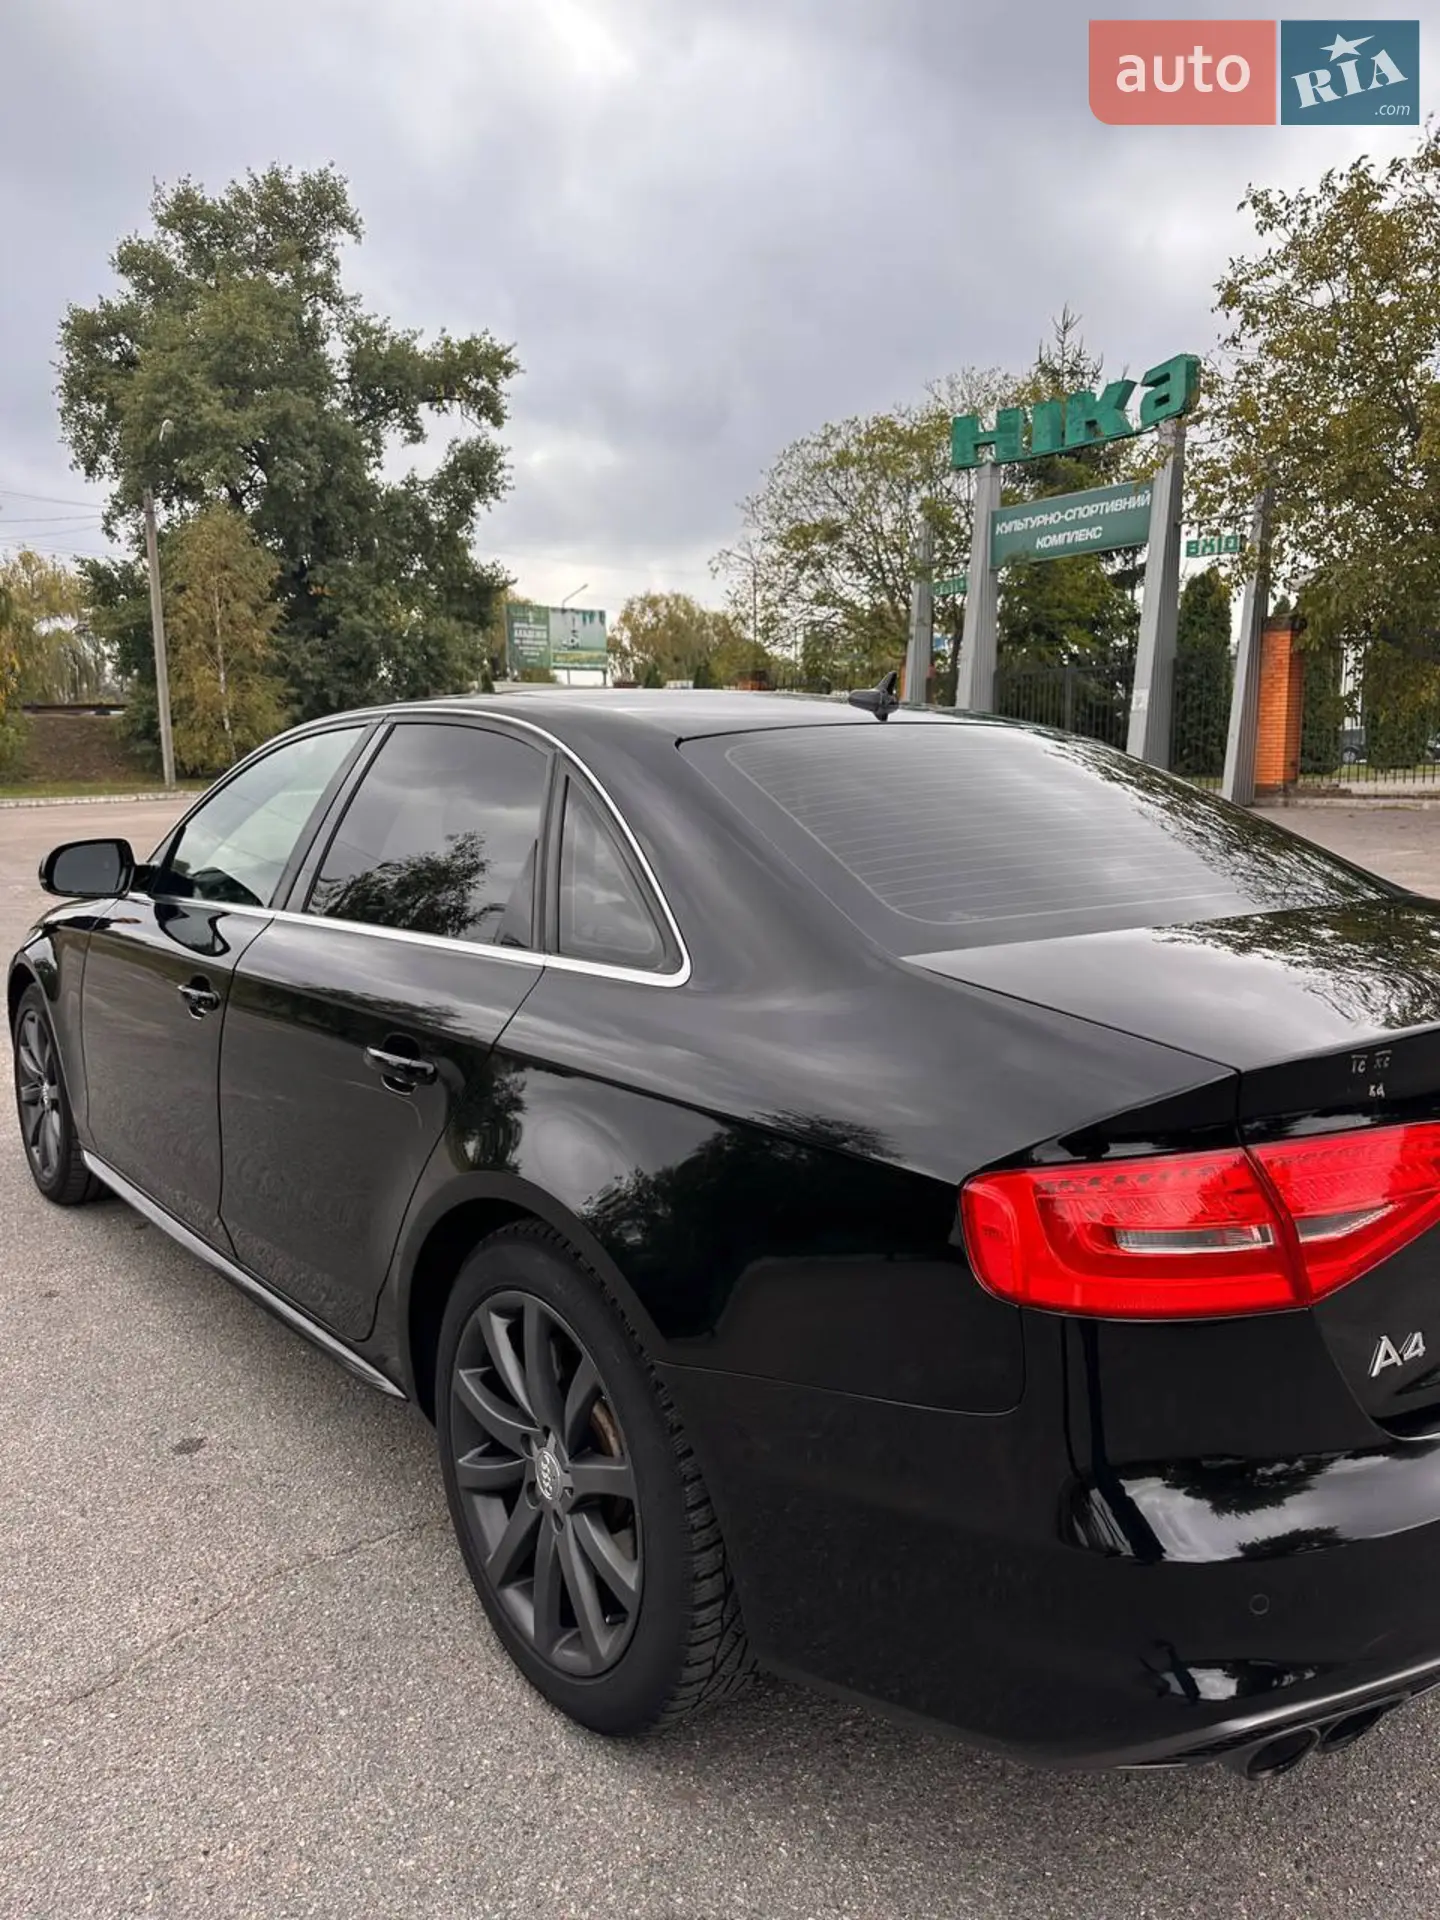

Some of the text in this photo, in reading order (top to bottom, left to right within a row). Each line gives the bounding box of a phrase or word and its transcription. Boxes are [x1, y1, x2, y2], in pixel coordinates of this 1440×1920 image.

[995, 490, 1151, 536] КУЛЬТУРНО-СПОРТИВНИЙ
[1035, 526, 1103, 550] КОМПЛЕКС
[1368, 1331, 1426, 1378] A4
